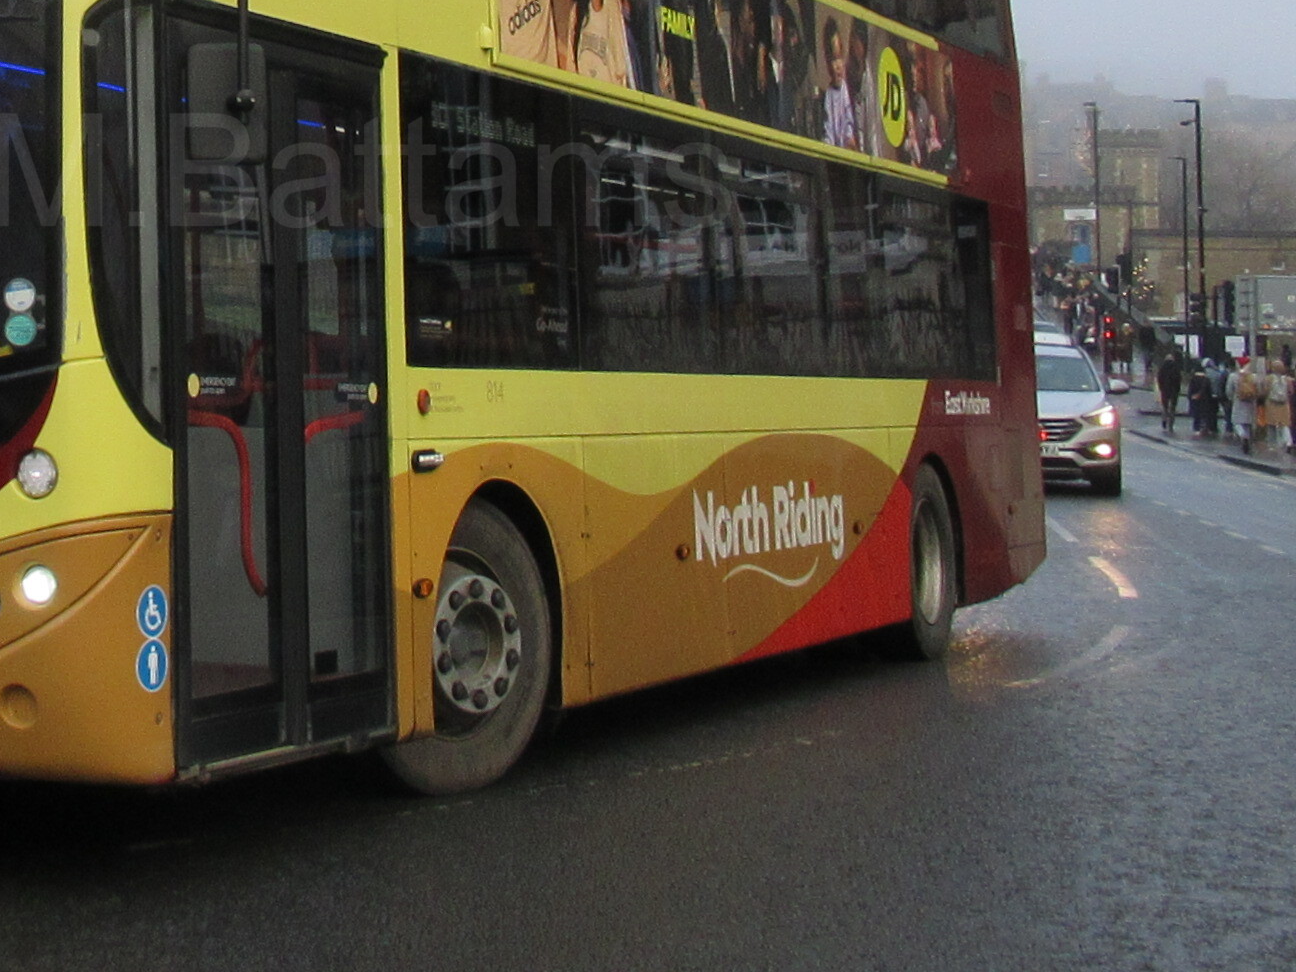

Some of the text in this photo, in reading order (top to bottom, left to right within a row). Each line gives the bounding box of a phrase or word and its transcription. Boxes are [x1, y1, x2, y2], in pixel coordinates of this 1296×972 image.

[660, 5, 696, 41] FAMILY
[881, 71, 903, 121] JD
[693, 478, 845, 568] North Riding
